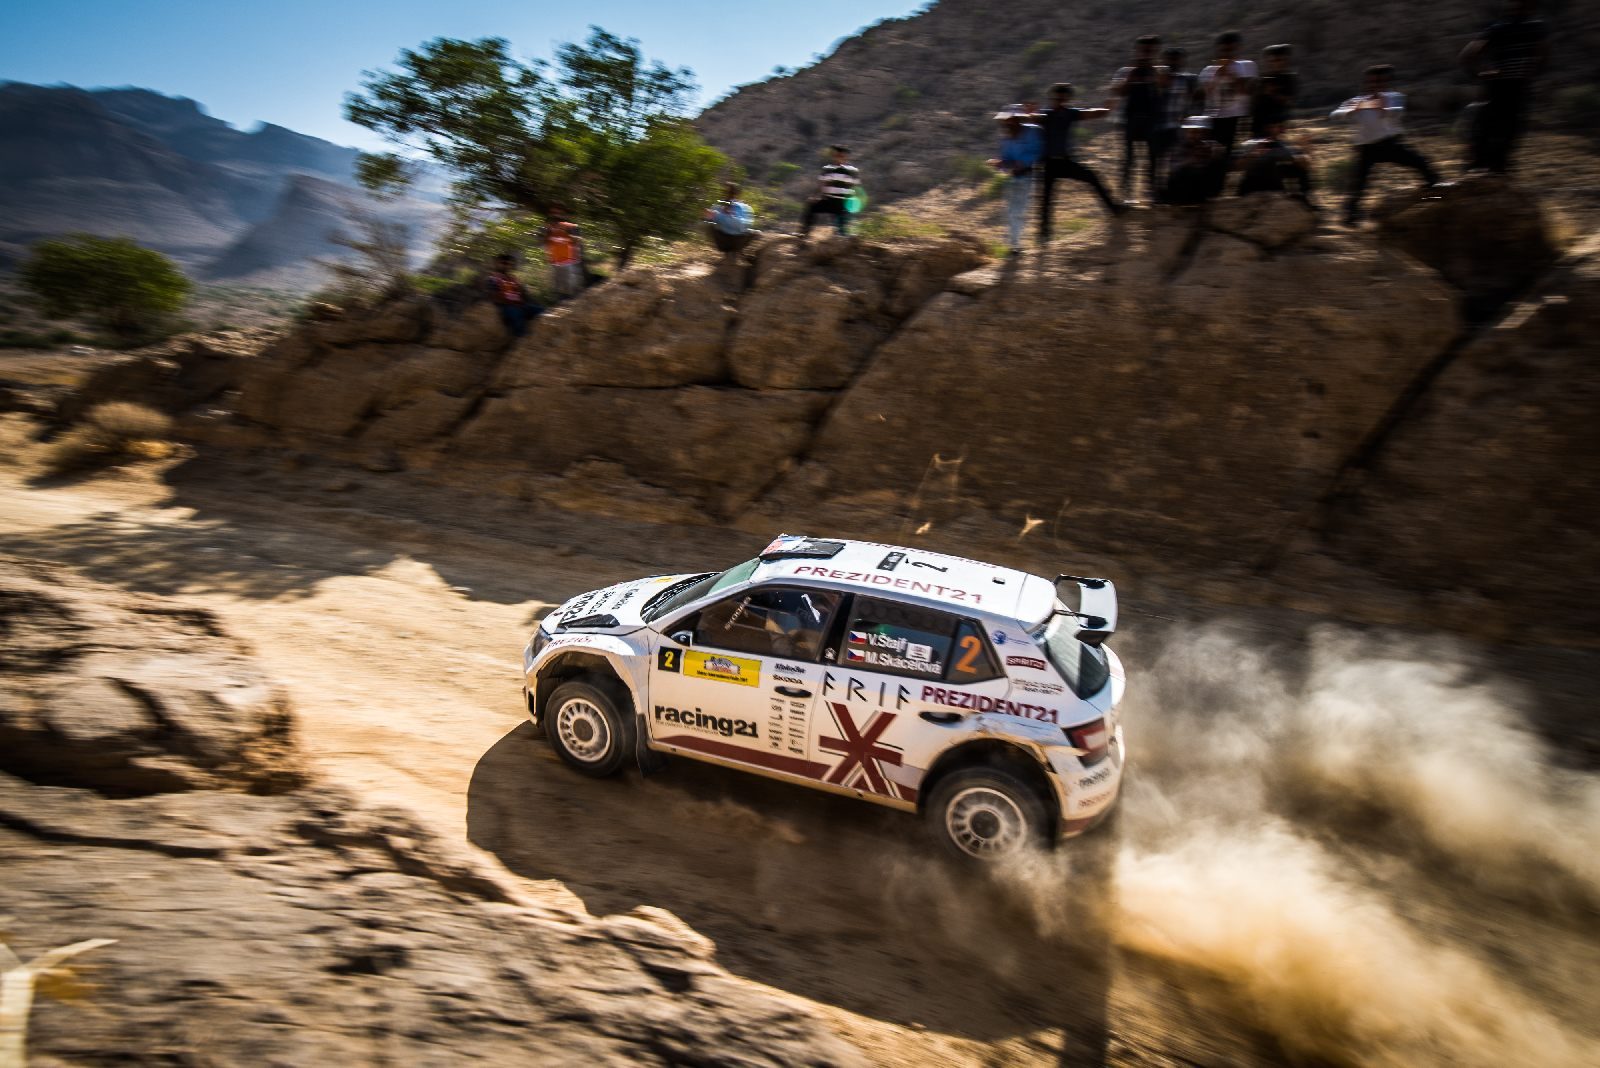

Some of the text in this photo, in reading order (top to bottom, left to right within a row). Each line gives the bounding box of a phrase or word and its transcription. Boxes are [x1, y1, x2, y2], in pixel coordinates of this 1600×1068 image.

[793, 566, 984, 604] PREZIDENT21
[664, 651, 673, 668] 2
[955, 635, 983, 674] 2
[654, 705, 759, 738] racing21
[921, 685, 1058, 724] PREZIDENT21
